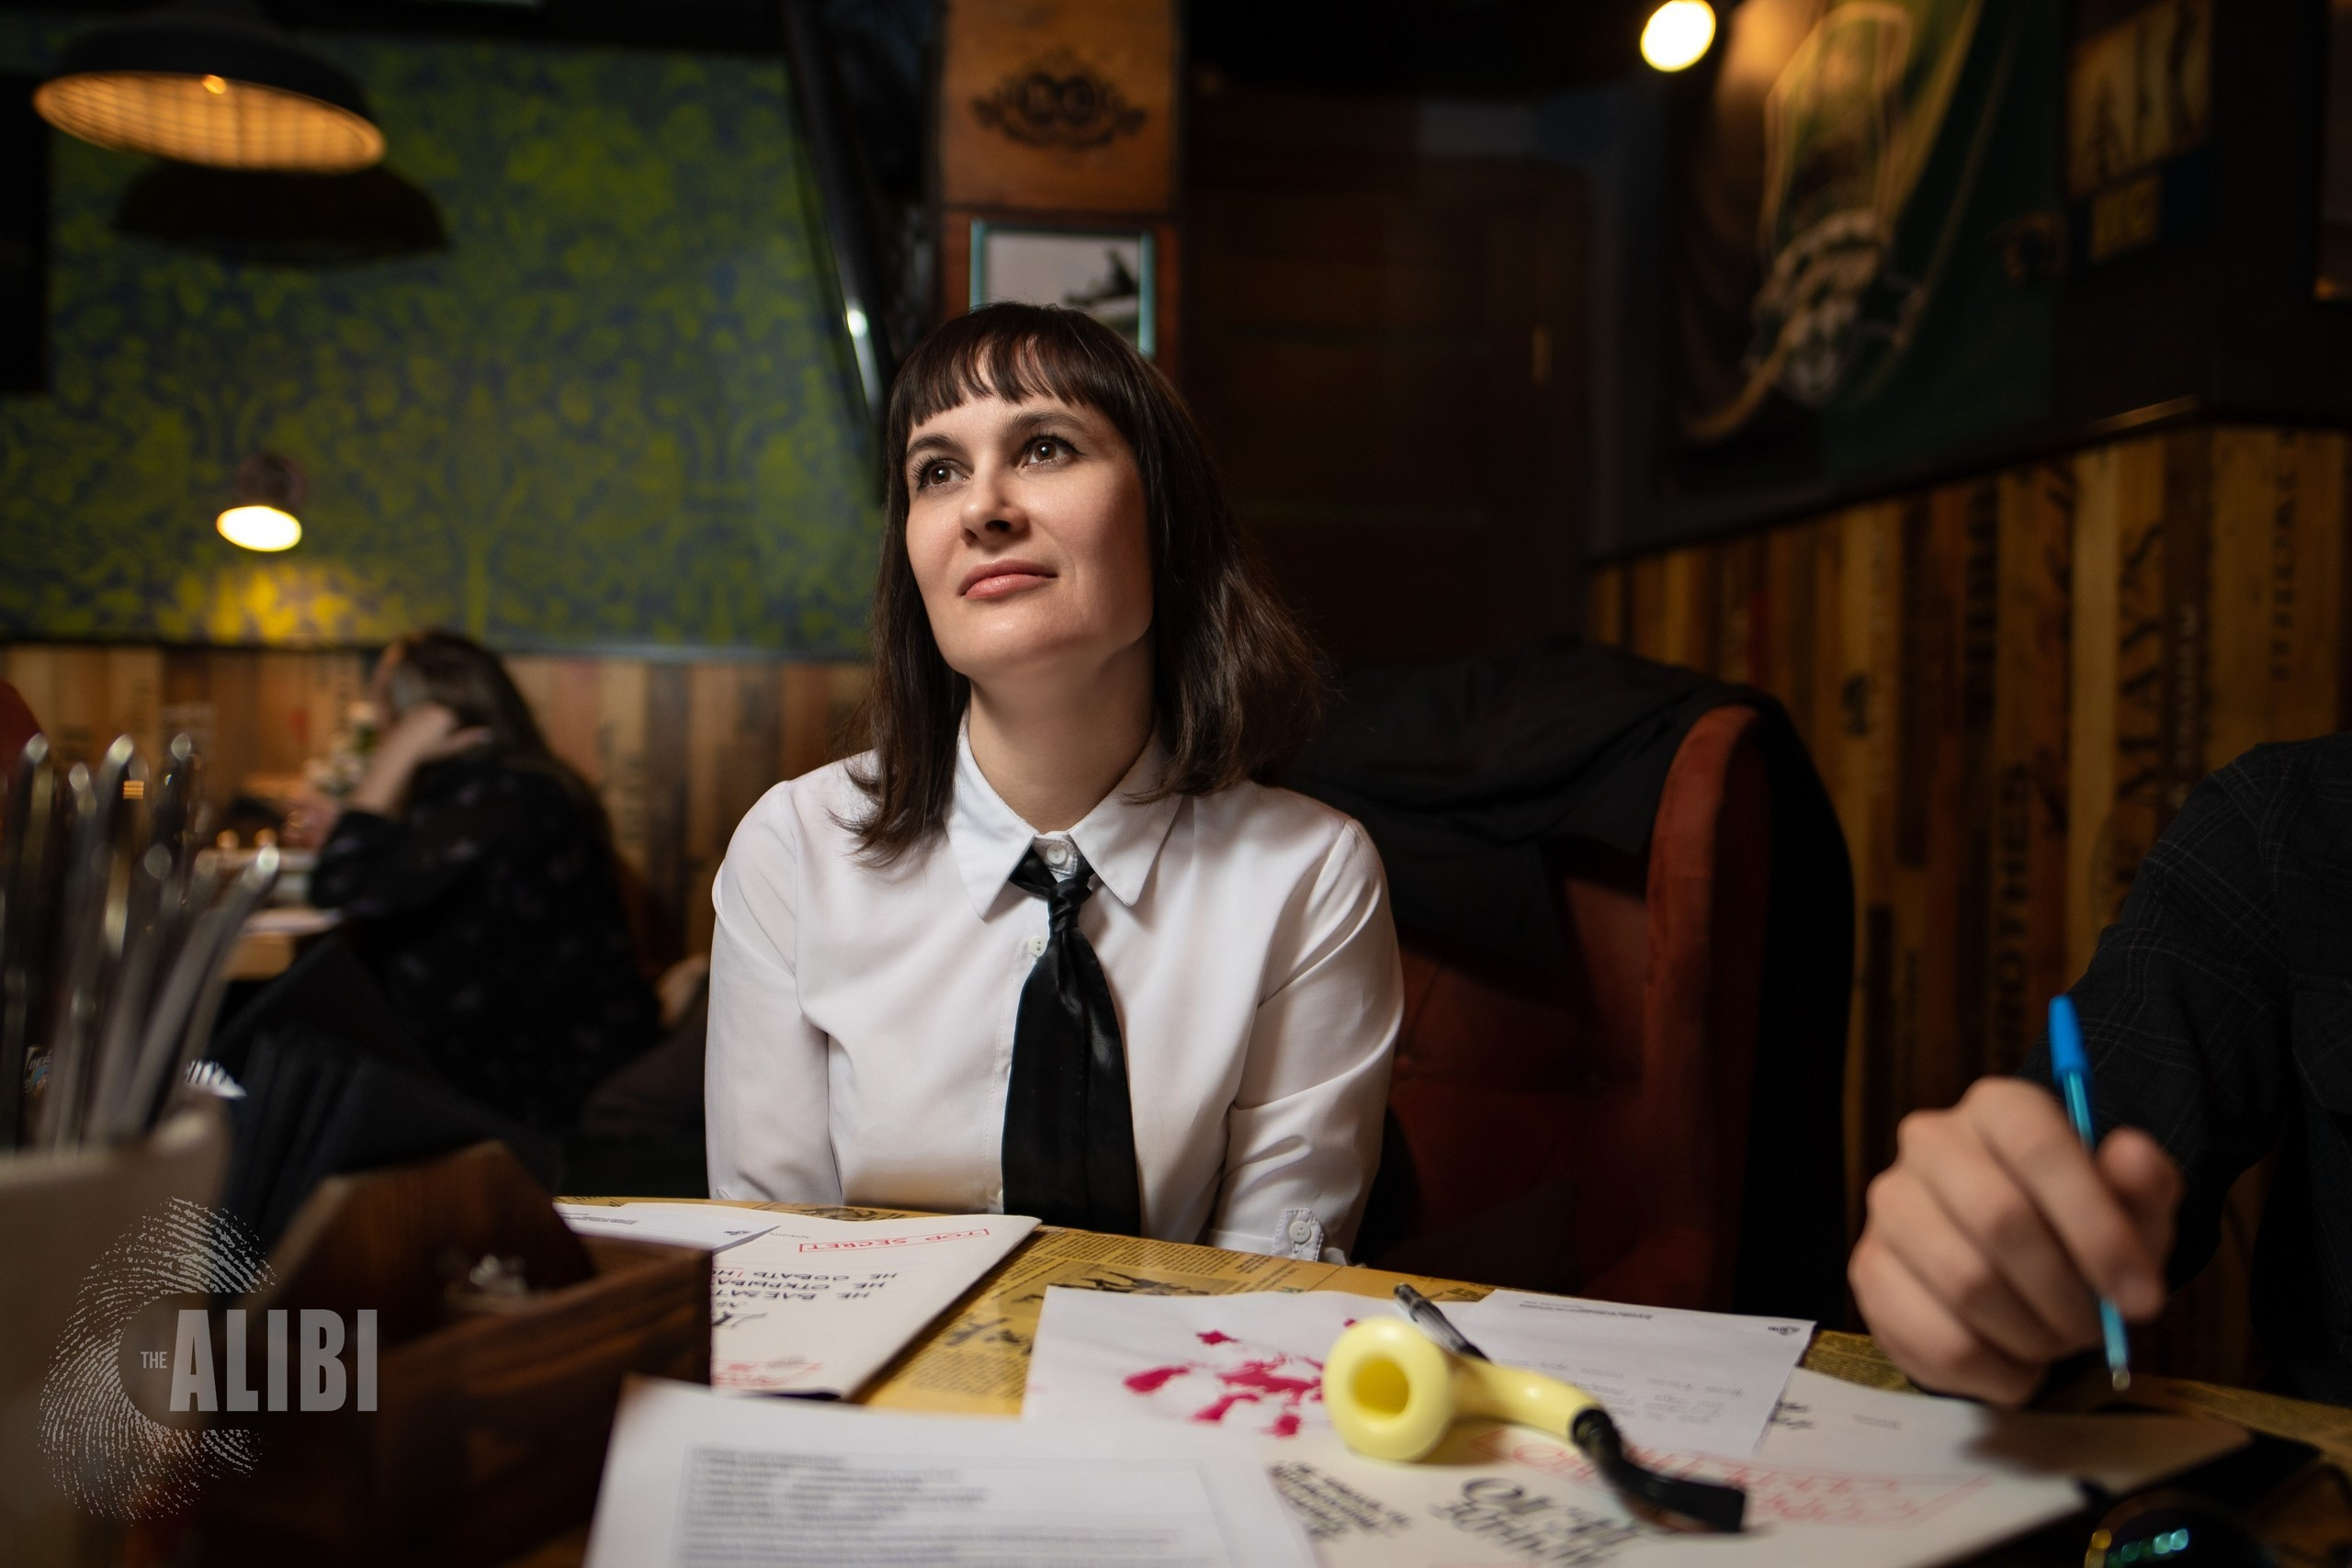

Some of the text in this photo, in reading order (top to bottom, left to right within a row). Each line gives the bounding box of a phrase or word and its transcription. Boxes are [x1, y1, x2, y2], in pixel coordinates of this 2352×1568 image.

[807, 1231, 983, 1250] TOP SECRET
[870, 1271, 898, 1280] НЕ
[711, 1278, 886, 1290] НЕ ОТКРЫВА
[837, 1291, 871, 1299] НЕ
